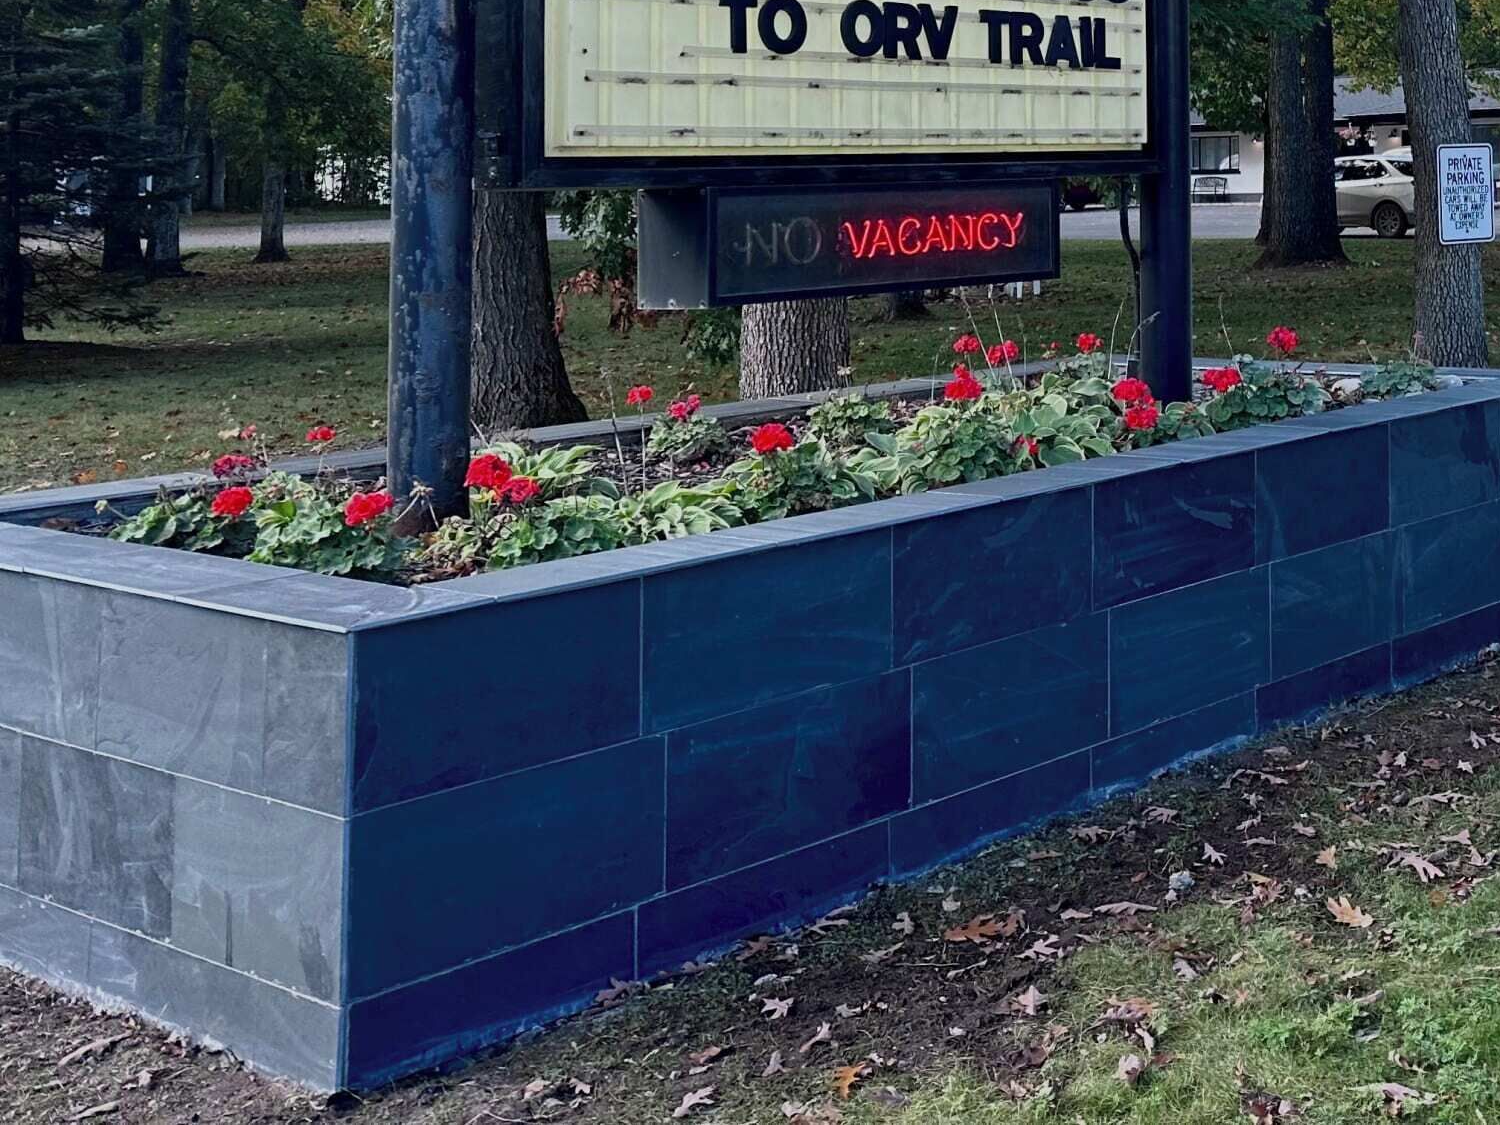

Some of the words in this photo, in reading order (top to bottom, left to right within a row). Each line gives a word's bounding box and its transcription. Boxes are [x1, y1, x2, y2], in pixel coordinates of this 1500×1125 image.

[841, 0, 958, 61] ORV
[980, 10, 1121, 70] TRAIL
[1448, 158, 1483, 171] PRIVATE
[1447, 172, 1485, 185] PARKING
[1443, 185, 1489, 195] UNAUTHORIZED
[1445, 195, 1461, 204] CARS
[1463, 195, 1478, 203] WILL
[1480, 194, 1488, 203] BE
[1448, 204, 1468, 213] TOWED
[1471, 203, 1485, 212] AWAY
[1450, 212, 1457, 220] AT
[1455, 220, 1479, 230] EXPENSE
[738, 216, 822, 265] NO
[844, 212, 1023, 259] VACANCY
